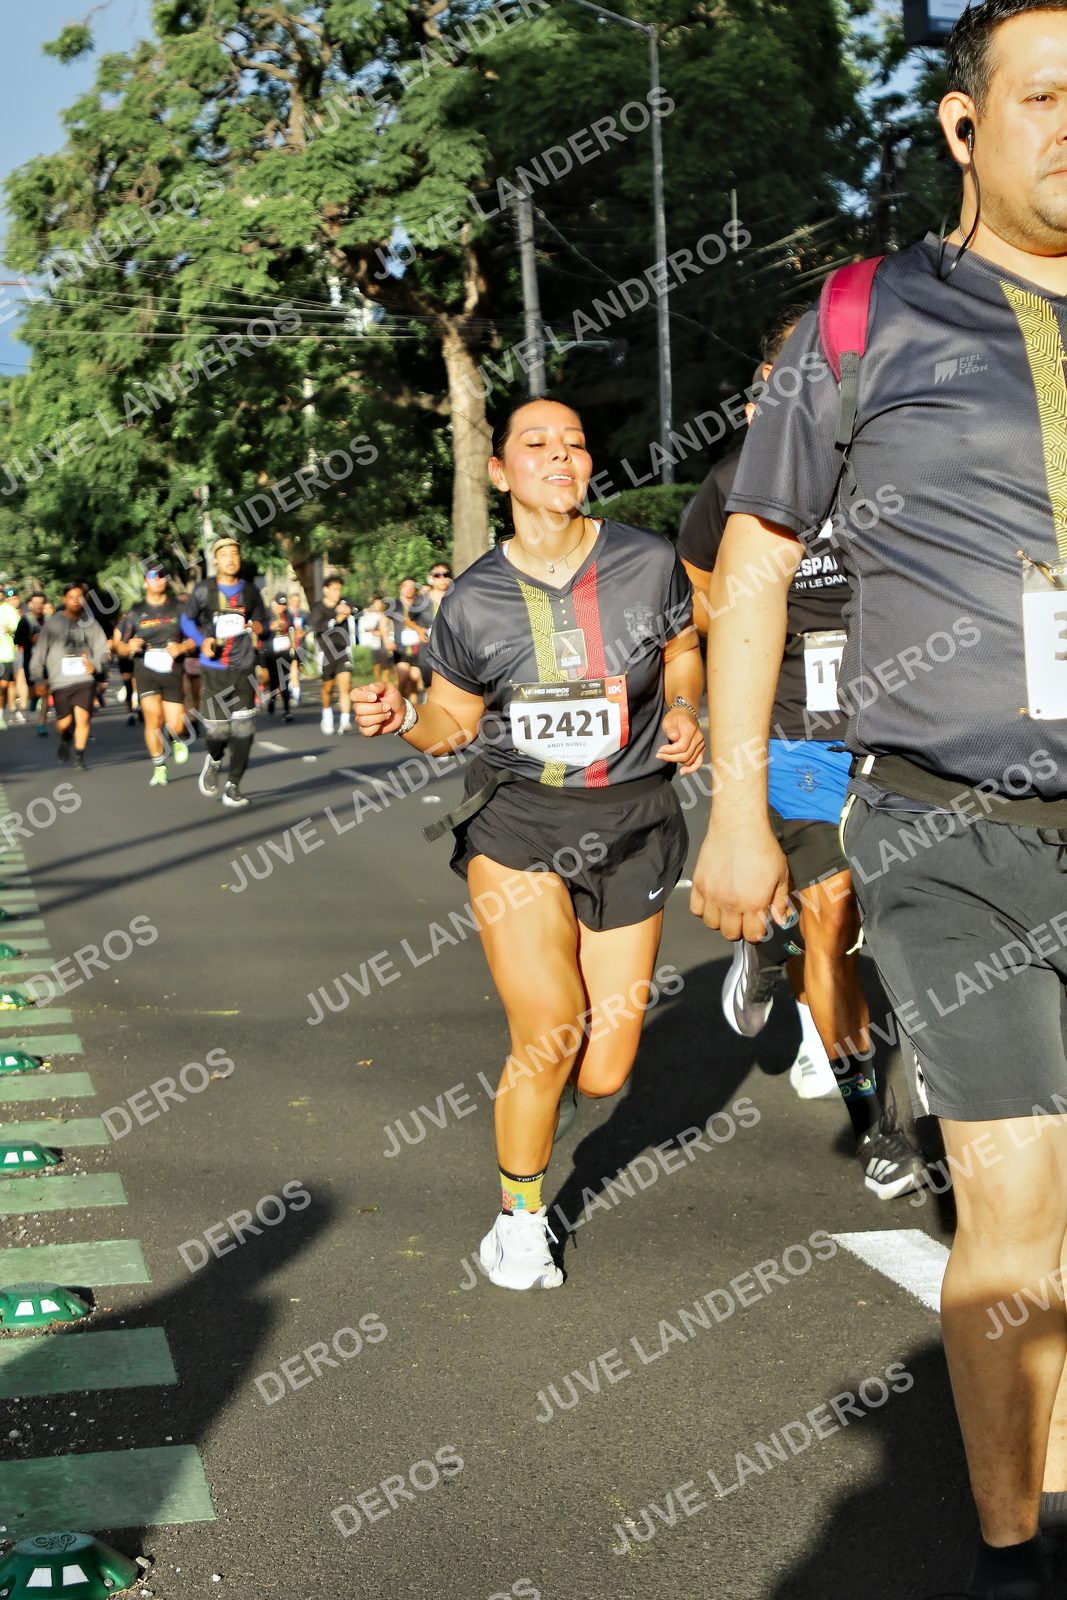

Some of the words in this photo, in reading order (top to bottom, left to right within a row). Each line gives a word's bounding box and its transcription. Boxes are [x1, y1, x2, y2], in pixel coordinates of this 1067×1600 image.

[959, 354, 982, 363] PIEL
[809, 578, 823, 588] LE
[517, 708, 610, 740] 12421
